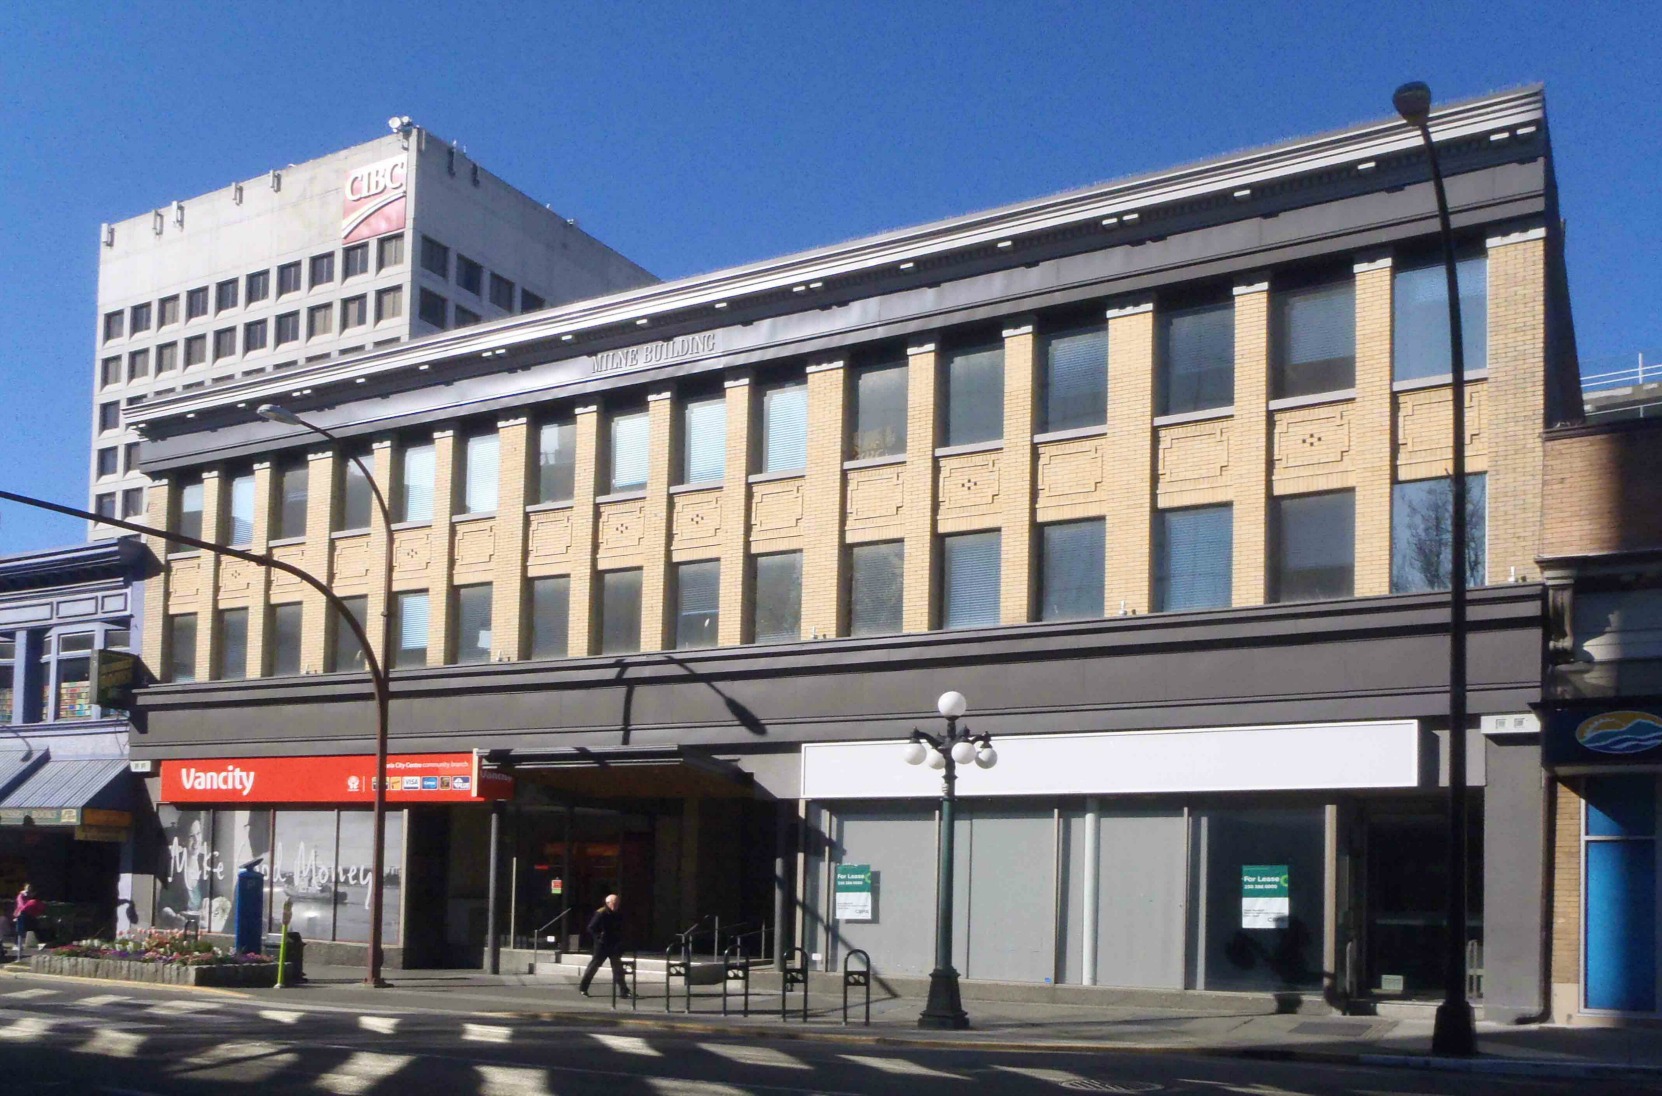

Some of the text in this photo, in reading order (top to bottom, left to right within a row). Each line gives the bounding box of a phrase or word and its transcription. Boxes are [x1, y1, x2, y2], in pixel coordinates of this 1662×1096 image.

[345, 162, 404, 202] CIBC
[592, 333, 716, 374] MILNE BUILDING
[181, 765, 255, 796] Vancity
[395, 761, 405, 770] City
[234, 842, 287, 883] od
[294, 841, 373, 910] Money
